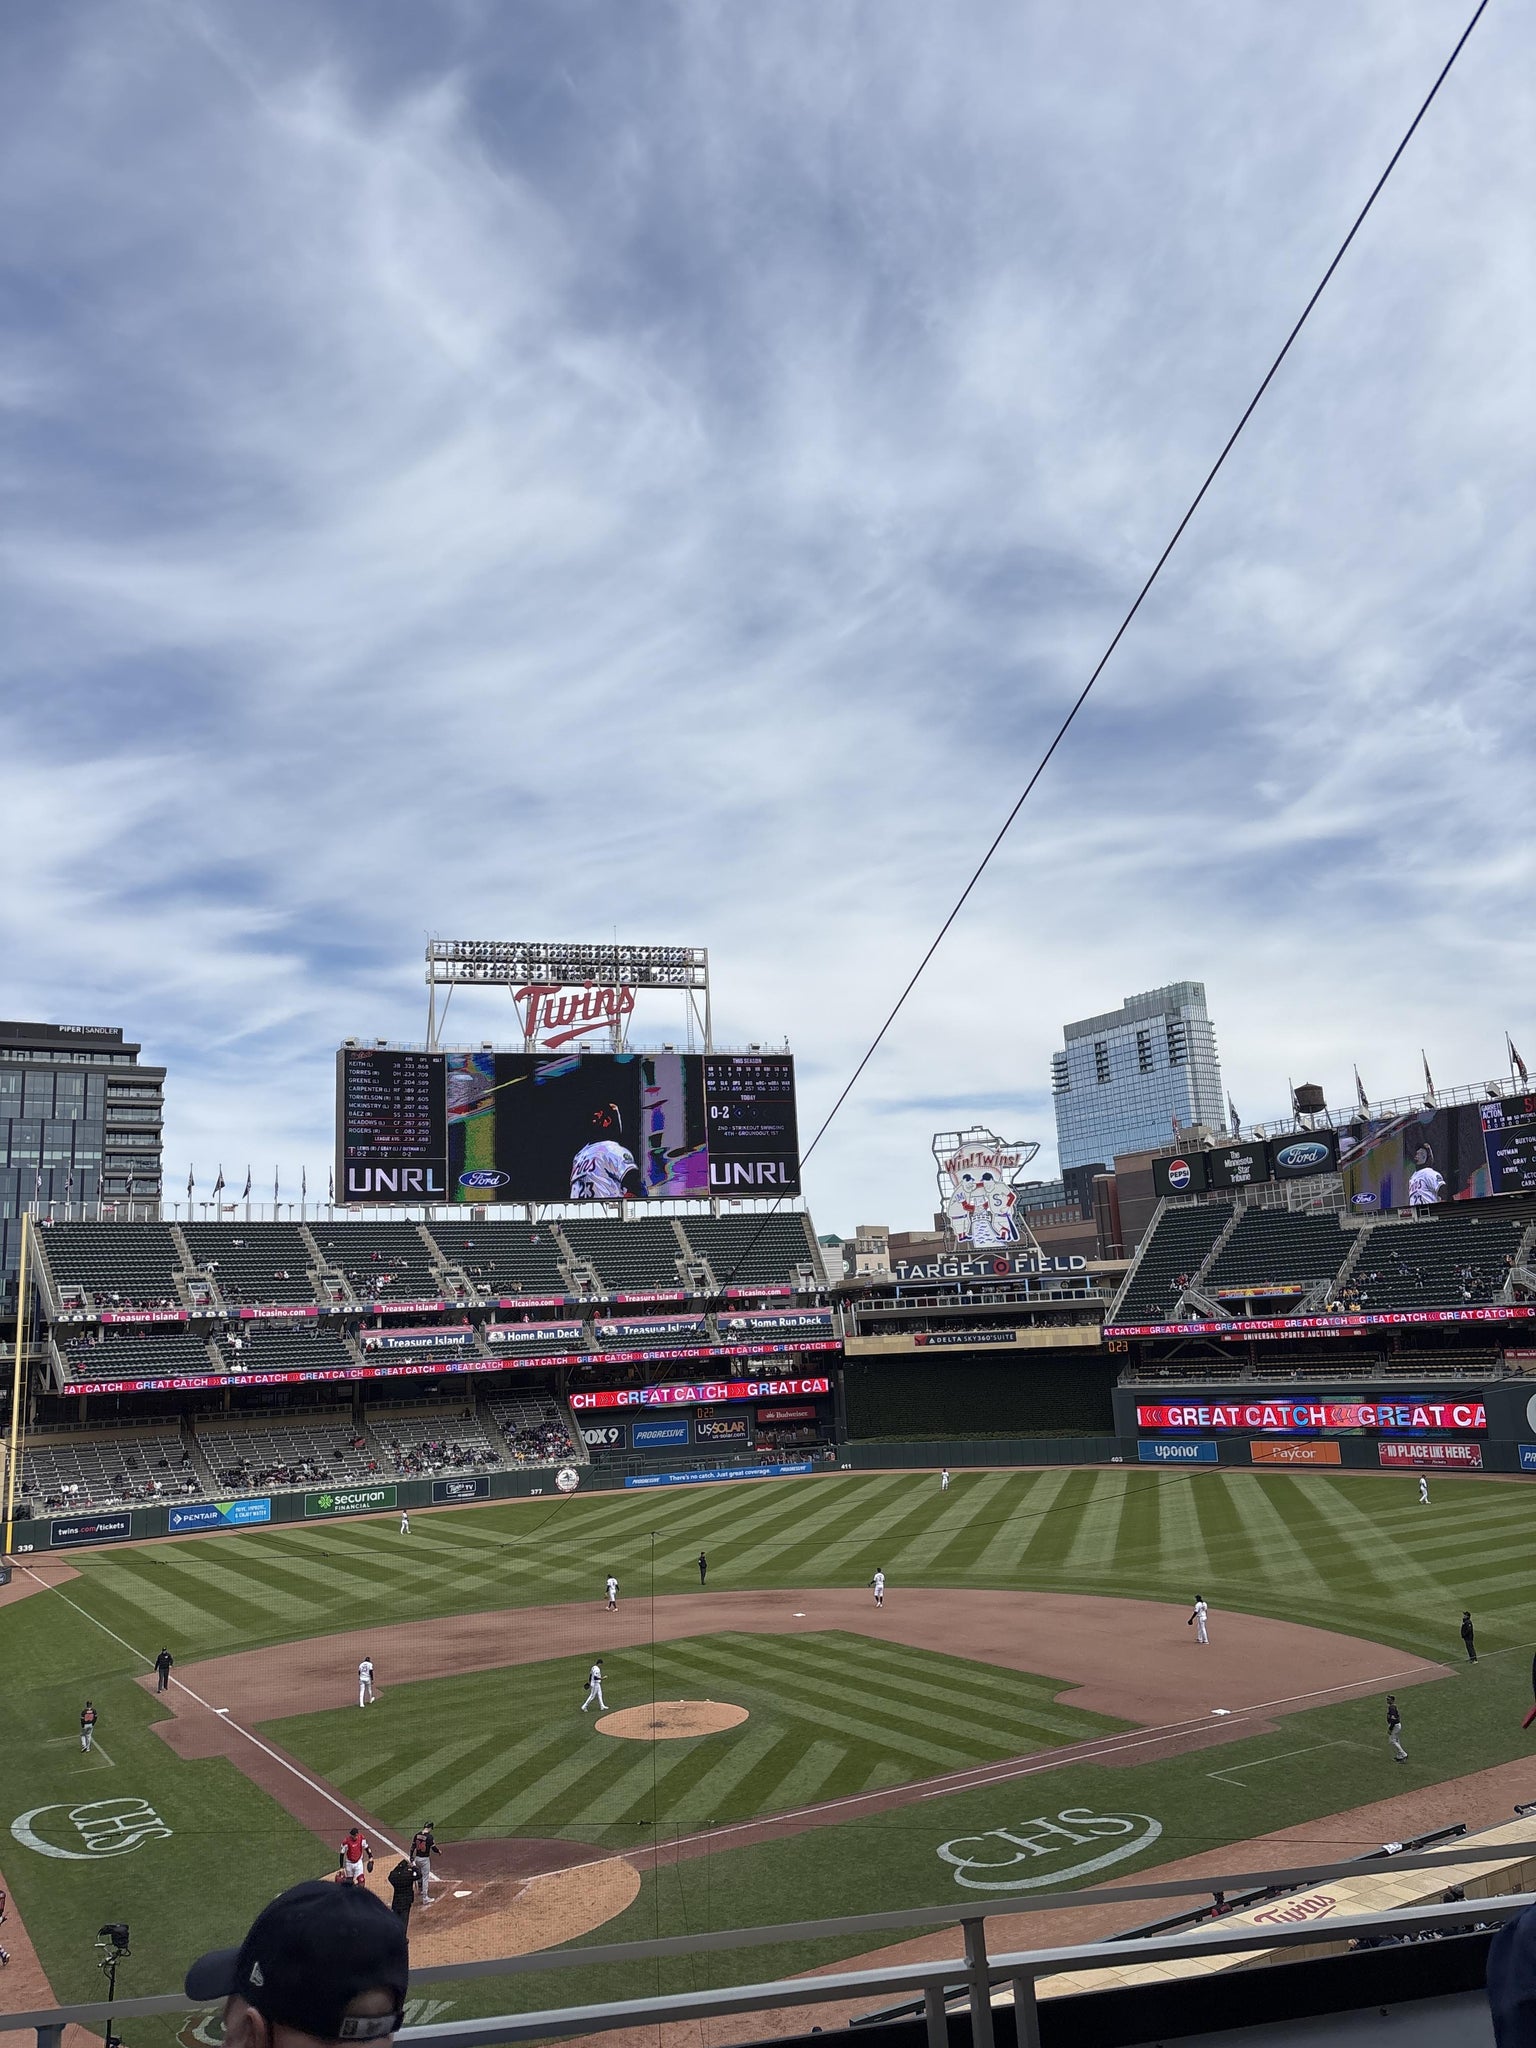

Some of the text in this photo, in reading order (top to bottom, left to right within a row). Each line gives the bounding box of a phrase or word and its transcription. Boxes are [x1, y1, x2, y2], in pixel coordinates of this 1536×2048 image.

[514, 980, 634, 1039] Twins
[59, 1025, 118, 1035] PIPER SANDLER
[711, 1106, 730, 1119] 0-2
[1481, 1102, 1502, 1112] GARRETT
[1482, 1109, 1503, 1120] ACTON
[1287, 1147, 1318, 1164] Ford
[1496, 1148, 1518, 1157] OUTMAN
[944, 1147, 1022, 1173] Win! Twins!
[1224, 1156, 1254, 1168] Minnesota
[1512, 1157, 1527, 1165] GRAY
[710, 1162, 796, 1185] UNRL
[1170, 1170, 1190, 1178] PEPSI
[1238, 1166, 1250, 1174] Star
[1502, 1166, 1518, 1174] LEWIS
[348, 1168, 445, 1192] UNRL
[468, 1172, 500, 1186] Ford
[1230, 1173, 1251, 1183] Tribune
[992, 1194, 1003, 1206] S
[1356, 1194, 1373, 1203] Ford
[896, 1255, 1086, 1280] TARGET FIELD
[381, 1304, 438, 1312] Treasure Island
[111, 1312, 179, 1322] Treasure Island
[752, 1316, 822, 1328] Home Run Deck
[1115, 1327, 1141, 1335] CATCH
[1150, 1326, 1177, 1334] GREAT
[1178, 1324, 1205, 1332] CATCH
[1215, 1322, 1242, 1331] GREAT
[1244, 1321, 1274, 1329] CATCH
[1284, 1319, 1314, 1327] GREAT
[1316, 1317, 1347, 1326] CATCH
[1359, 1315, 1390, 1324] GREAT
[1393, 1313, 1427, 1322] CATCH
[1439, 1311, 1476, 1320] GREAT
[1476, 1308, 1514, 1318] CATCH
[508, 1328, 580, 1342] Home Run Deck
[623, 1325, 665, 1335] Treasure
[1244, 1332, 1278, 1340] UNIVERSAL
[388, 1335, 465, 1348] Treasure Island
[85, 1342, 827, 1393] CATCH GREAT CATCH GREAT CATCH GREAT CATCH GREAT CATCH GREAT CATCH GREAT CATCH GREAT CATCH GREAT CATCH GREAT CATCH GREAT CATCH
[617, 1389, 670, 1405] GREAT
[674, 1386, 728, 1401] CATCH
[747, 1381, 798, 1395] GREAT
[776, 1410, 808, 1419] Budweiser
[1168, 1408, 1239, 1426] GREAT
[1245, 1406, 1326, 1426] CATCH
[1357, 1406, 1444, 1426] GREAT
[608, 1428, 619, 1443] 9
[636, 1428, 685, 1440] PROGRESSIVE
[1155, 1446, 1199, 1459] uponor
[1272, 1446, 1317, 1461] Paycor
[1388, 1445, 1472, 1459] NO PLACE LIKE HERE
[669, 1473, 690, 1481] There's
[698, 1472, 715, 1480] catch.
[729, 1470, 744, 1478] great
[744, 1468, 772, 1477] coverage.
[334, 1490, 385, 1504] securian
[335, 1502, 370, 1511] FINANCIAL
[183, 1512, 218, 1522] PENTAIR
[18, 1544, 34, 1552] 339
[68, 1798, 174, 1852] CHS
[936, 1808, 1134, 1868] CHS
[1254, 1894, 1336, 1924] Twins
